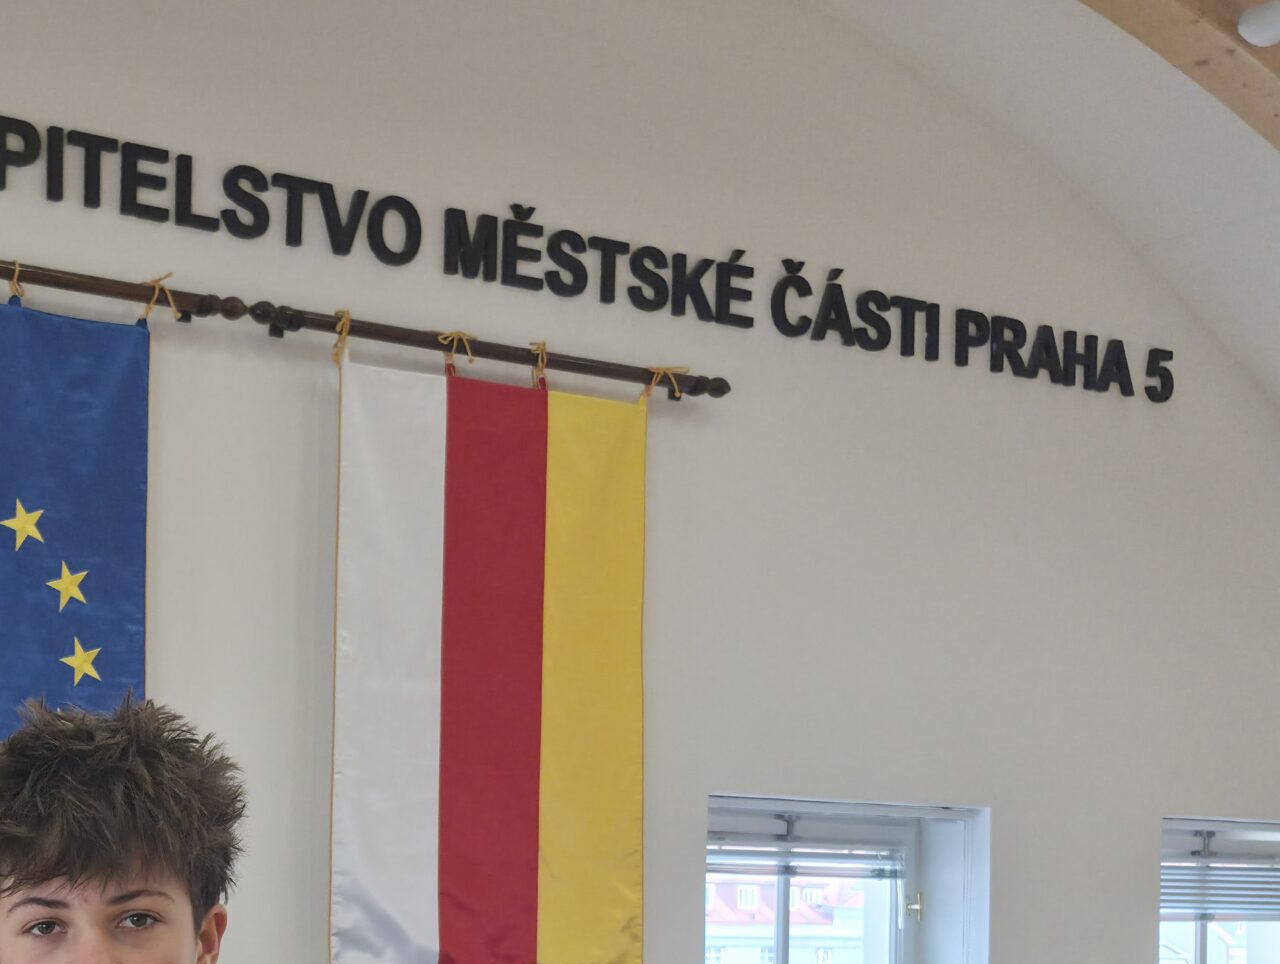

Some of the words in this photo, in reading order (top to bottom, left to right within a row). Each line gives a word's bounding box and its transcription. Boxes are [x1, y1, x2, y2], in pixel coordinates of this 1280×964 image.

[443, 203, 755, 329] MĚSTSKÉ
[770, 258, 940, 362] ČÁSTI
[954, 308, 1135, 398] PRAHA
[1143, 347, 1175, 404] 5
